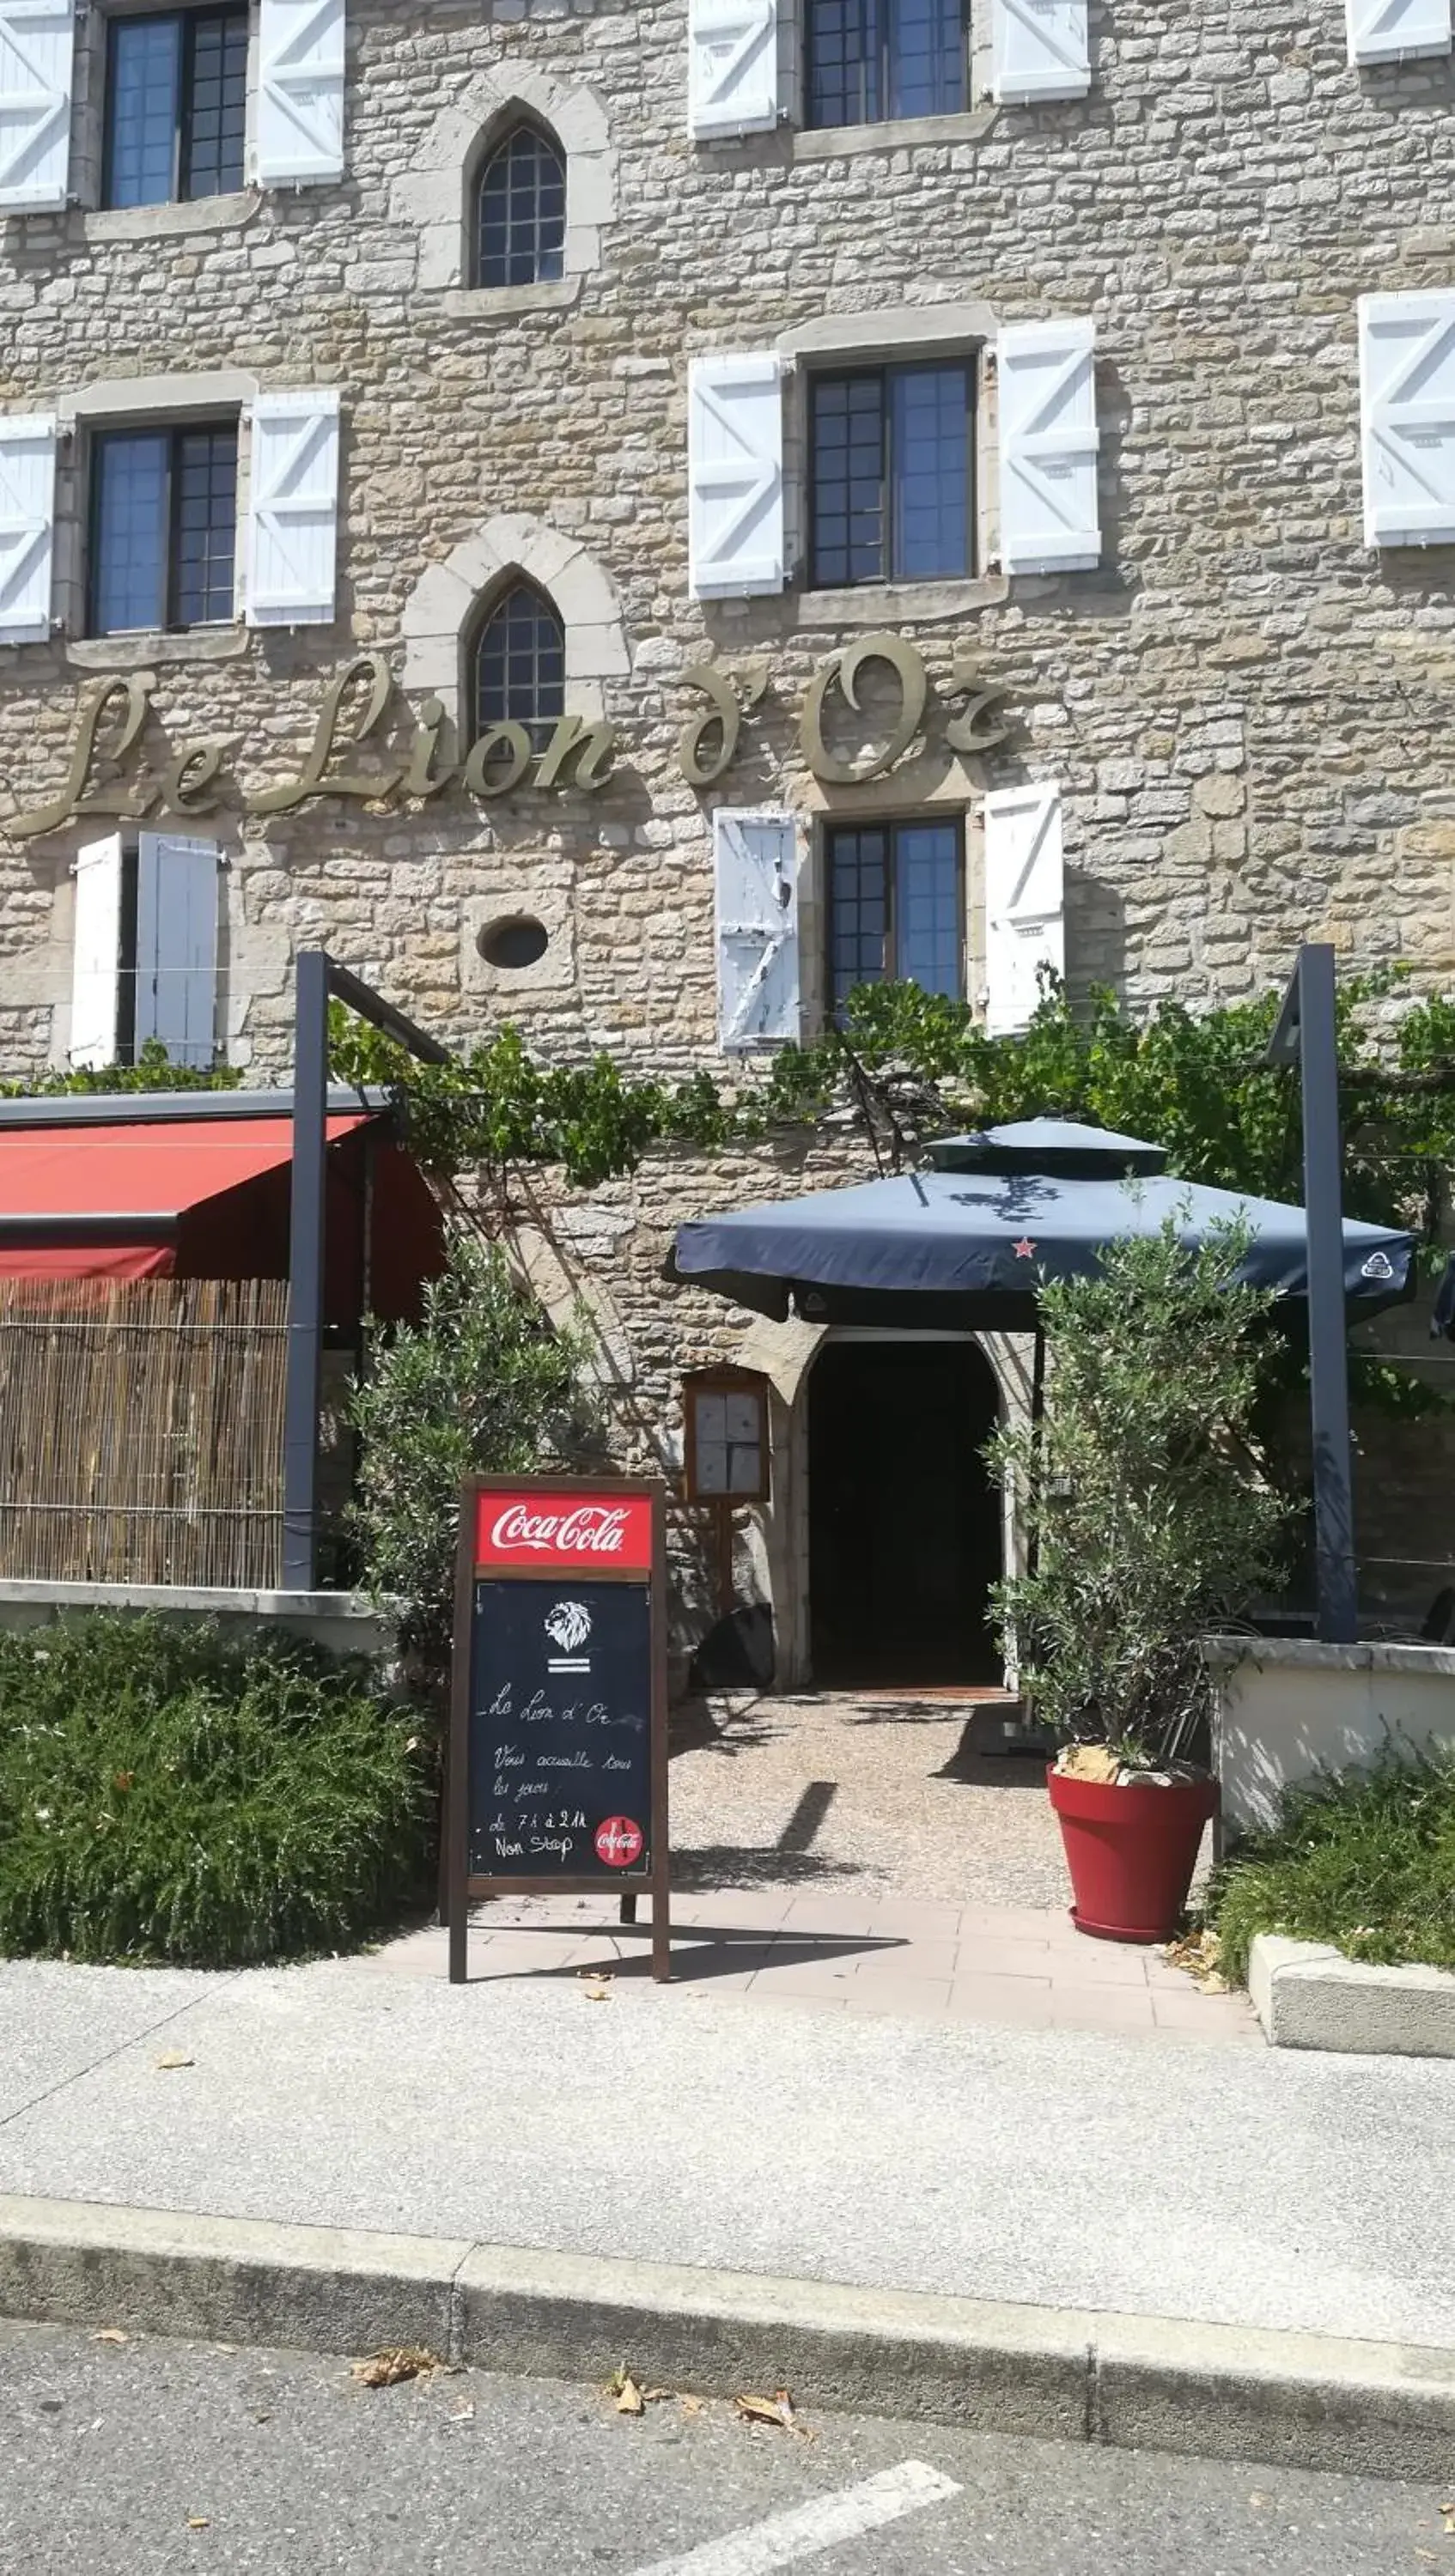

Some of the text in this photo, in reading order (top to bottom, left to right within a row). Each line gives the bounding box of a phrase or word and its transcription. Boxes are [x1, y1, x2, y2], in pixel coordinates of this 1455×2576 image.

[2, 671, 247, 838] Le
[247, 658, 615, 811] Lion
[491, 1504, 632, 1551] Coca-Cola
[489, 1682, 512, 1715] Le
[520, 1689, 554, 1721] Lion
[495, 1744, 525, 1769] Vous
[601, 1753, 632, 1770] tous
[494, 1774, 509, 1795] les
[489, 1813, 505, 1832] de
[545, 1813, 556, 1828] à
[495, 1835, 574, 1863] Non Stop
